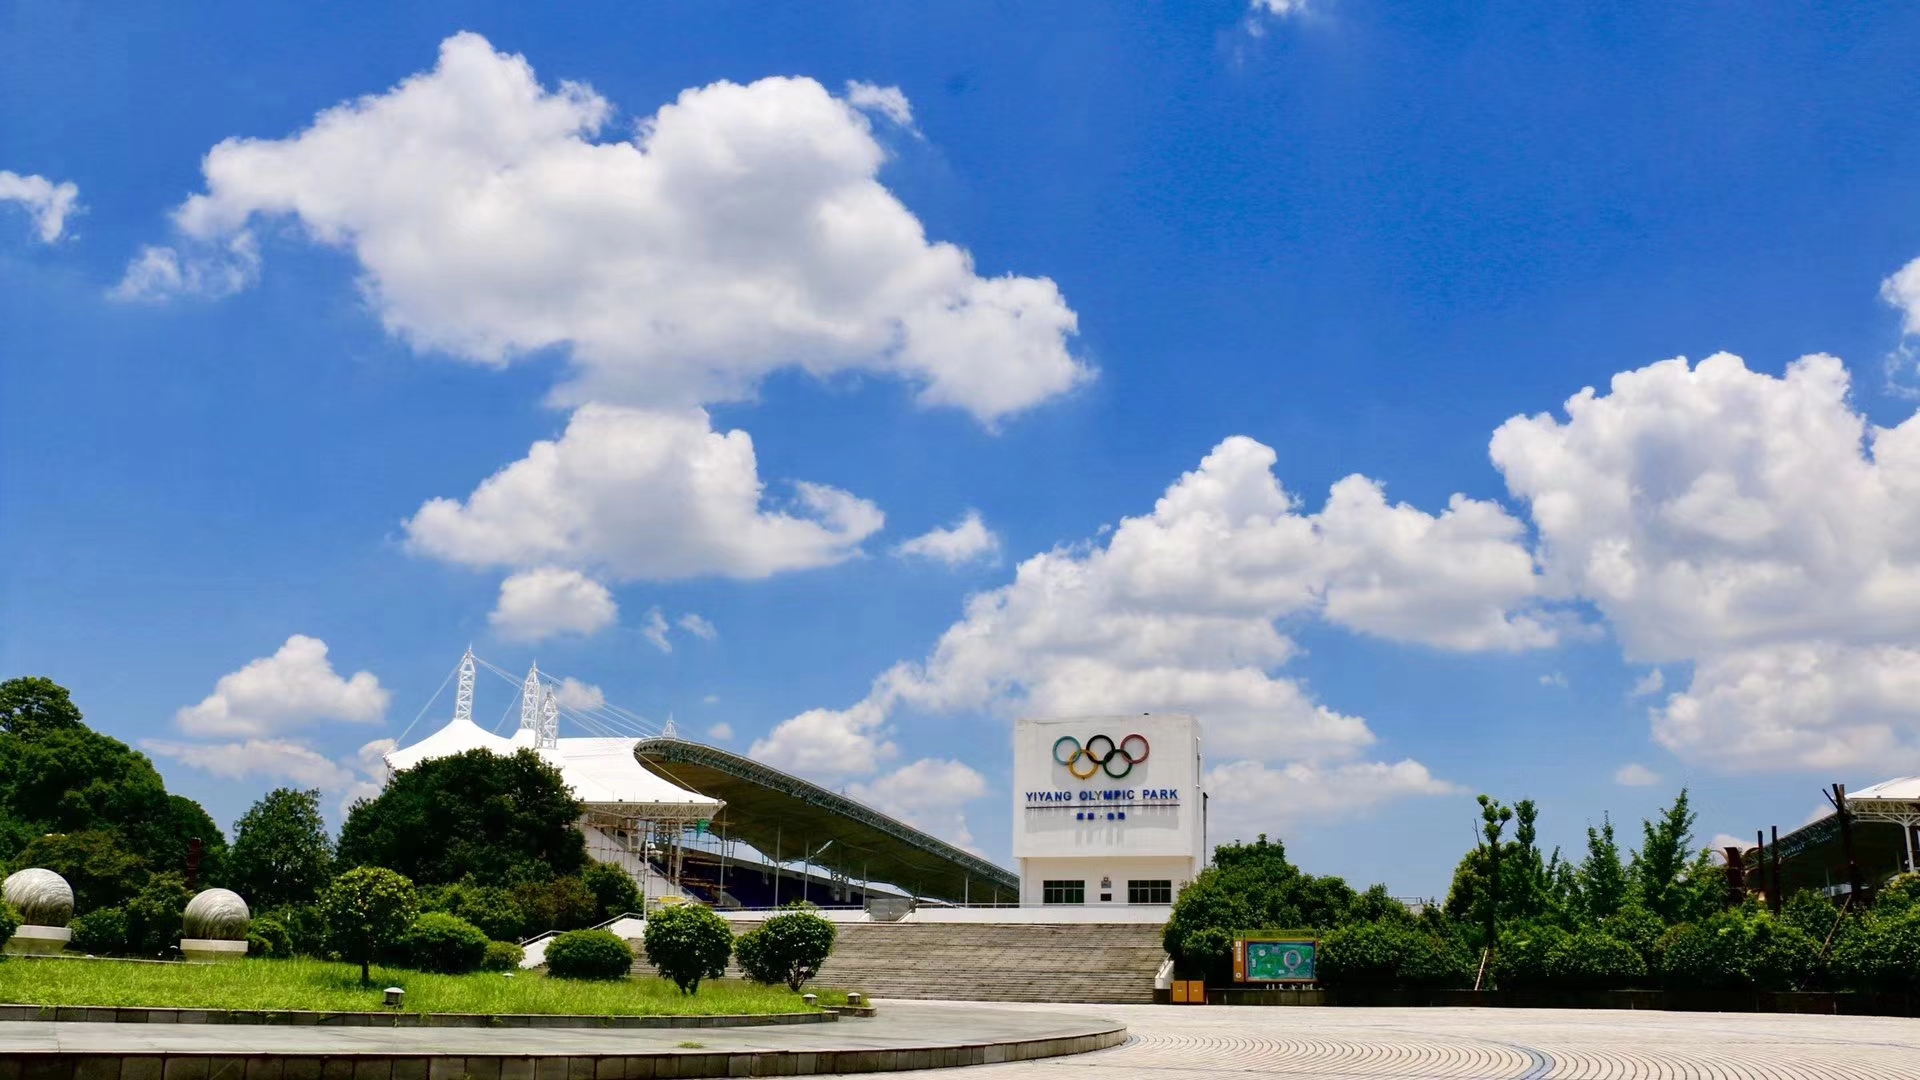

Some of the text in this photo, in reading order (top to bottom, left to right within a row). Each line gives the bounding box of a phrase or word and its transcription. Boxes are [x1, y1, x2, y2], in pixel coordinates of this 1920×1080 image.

[1025, 789, 1178, 801] YIYANG OLYMPIC PARK
